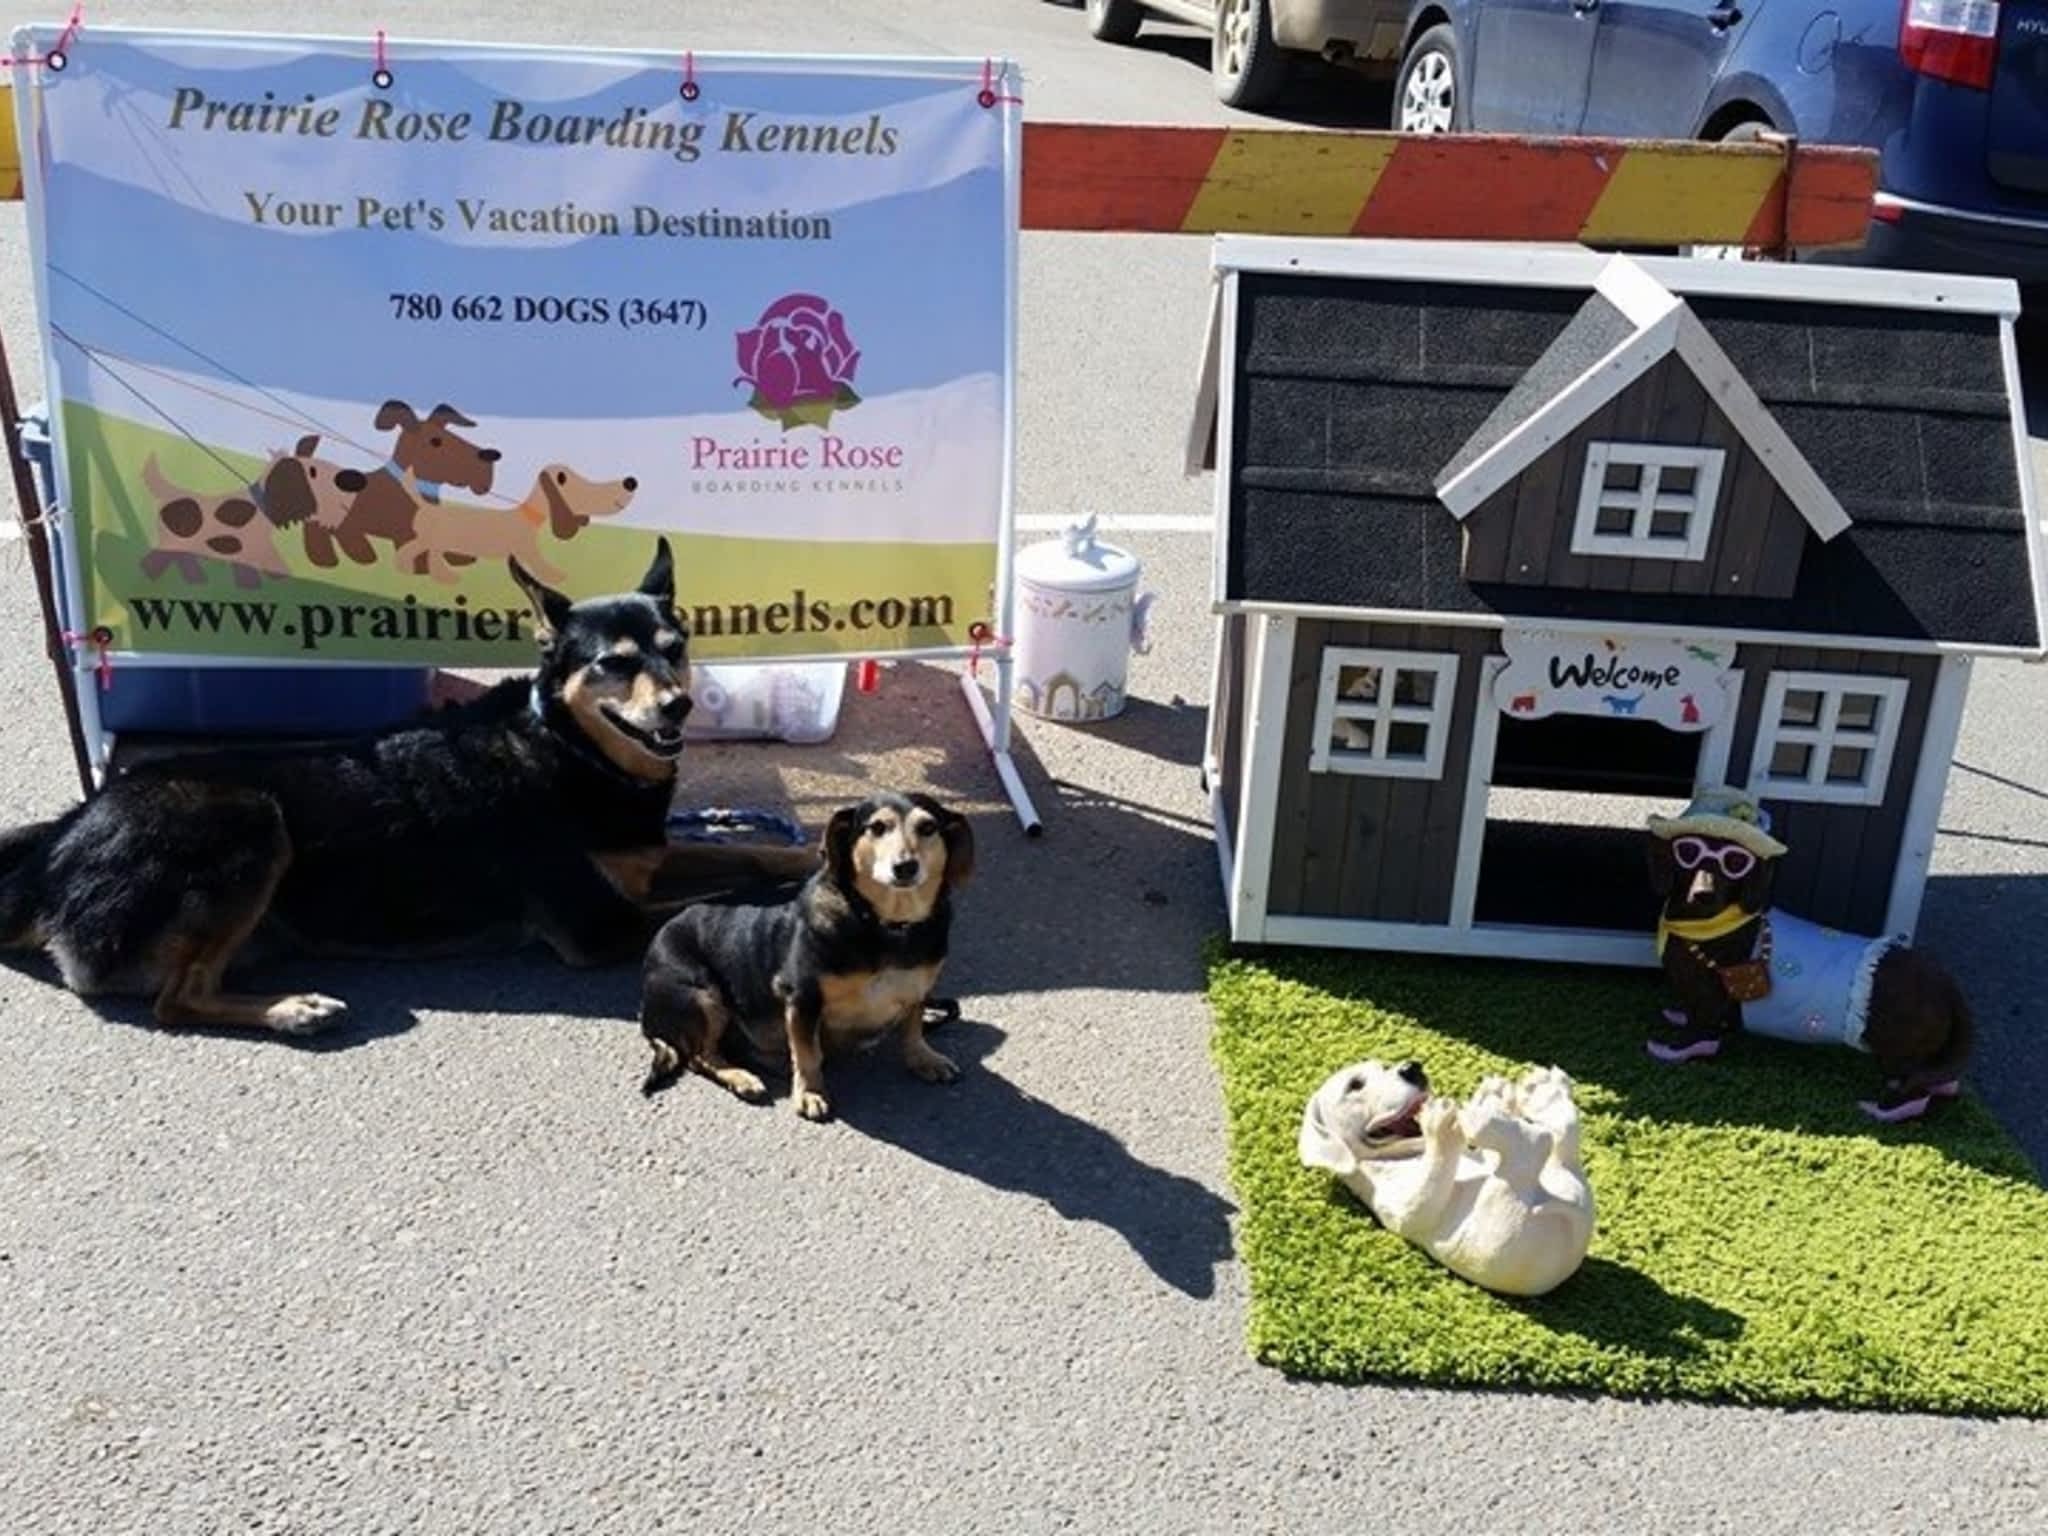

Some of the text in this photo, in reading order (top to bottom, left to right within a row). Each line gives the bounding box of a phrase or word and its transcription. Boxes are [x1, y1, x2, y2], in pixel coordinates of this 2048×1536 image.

[168, 87, 900, 163] Prairie Rose Boarding Kennels
[244, 192, 833, 241] Your Pet's Vacation Destination
[389, 293, 708, 331] 780 662 DOGS (3647)
[691, 435, 903, 470] Prairie Rose
[691, 479, 904, 494] BOARDING KENNELS
[1548, 653, 1681, 690] Welcome
